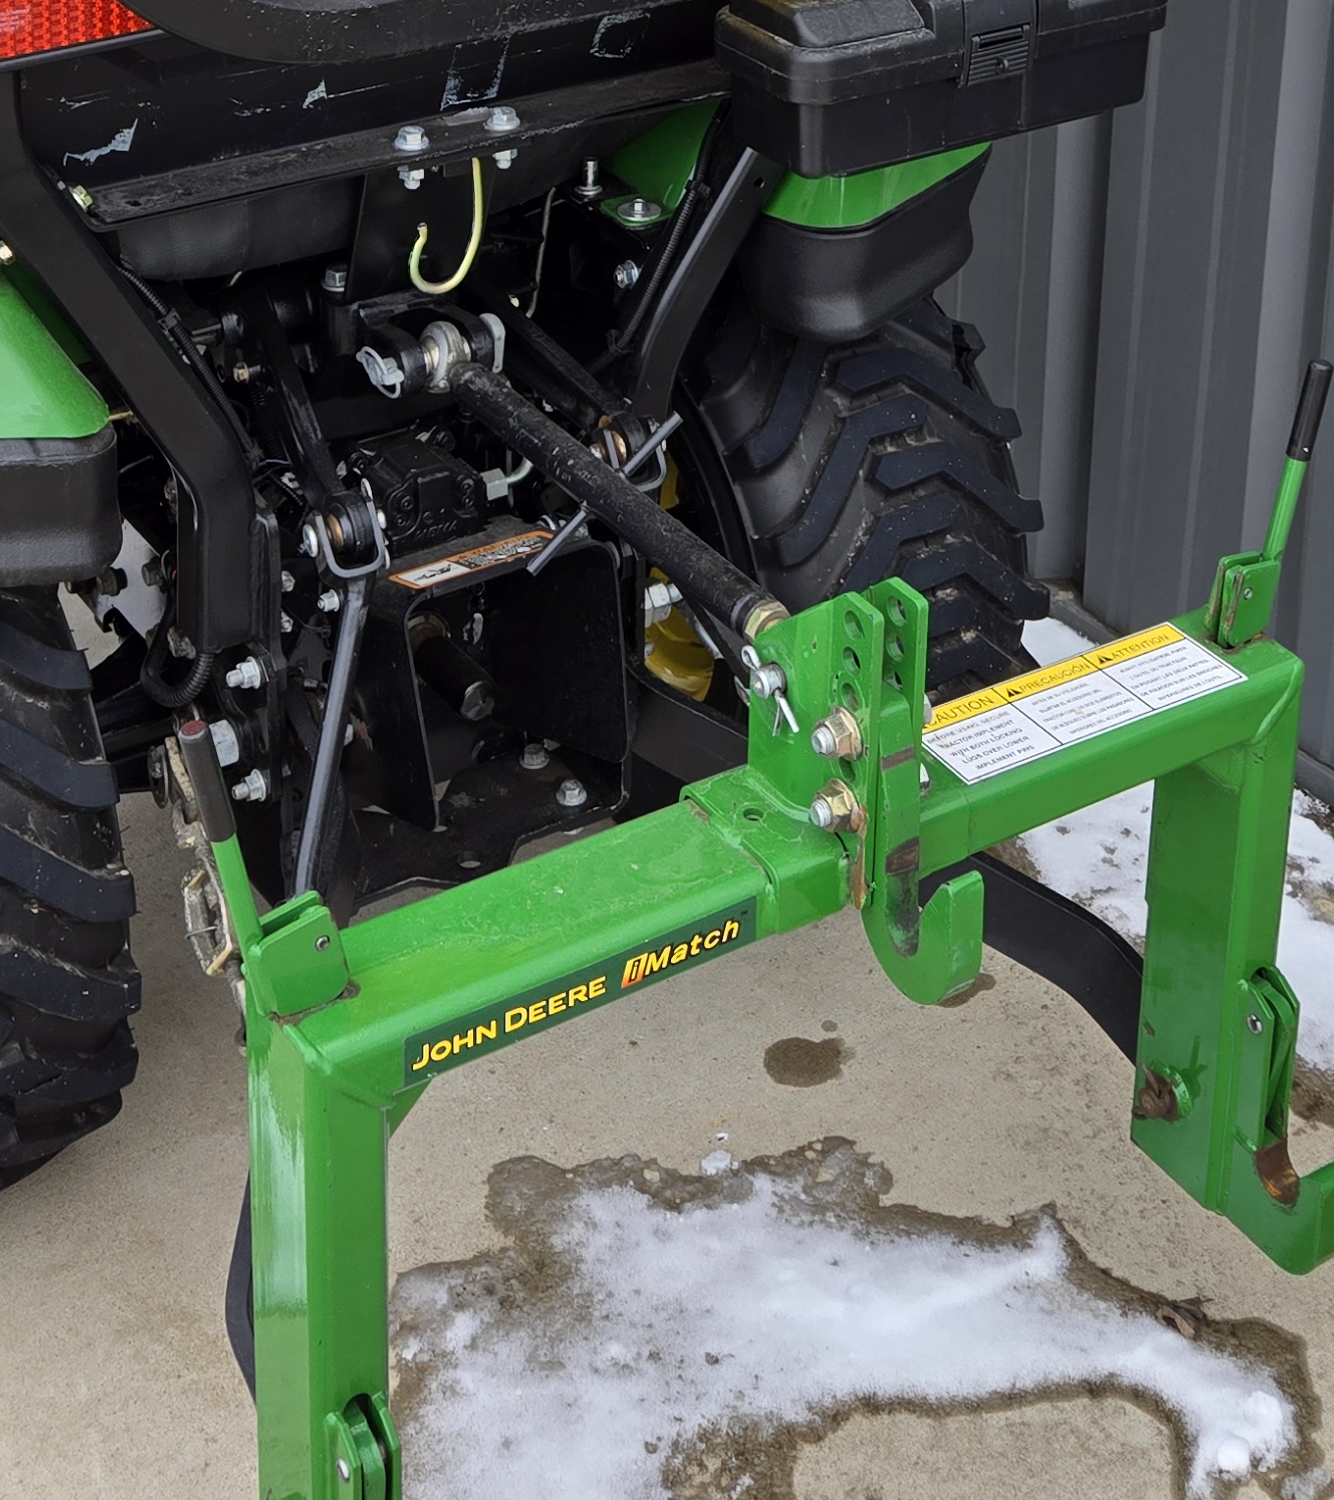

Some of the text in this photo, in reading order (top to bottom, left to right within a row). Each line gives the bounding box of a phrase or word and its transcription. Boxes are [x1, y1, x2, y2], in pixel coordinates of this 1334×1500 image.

[1110, 635, 1169, 658] ATTENTION
[969, 740, 989, 749] BOTH
[989, 728, 1022, 742] LOCKING
[973, 720, 1014, 737] IMPLEMENT
[961, 736, 1028, 763] LUGS OVER LOWER
[975, 752, 1017, 769] IMPLEMENT
[412, 1018, 497, 1071] JOHN
[504, 974, 607, 1034] DEERE
